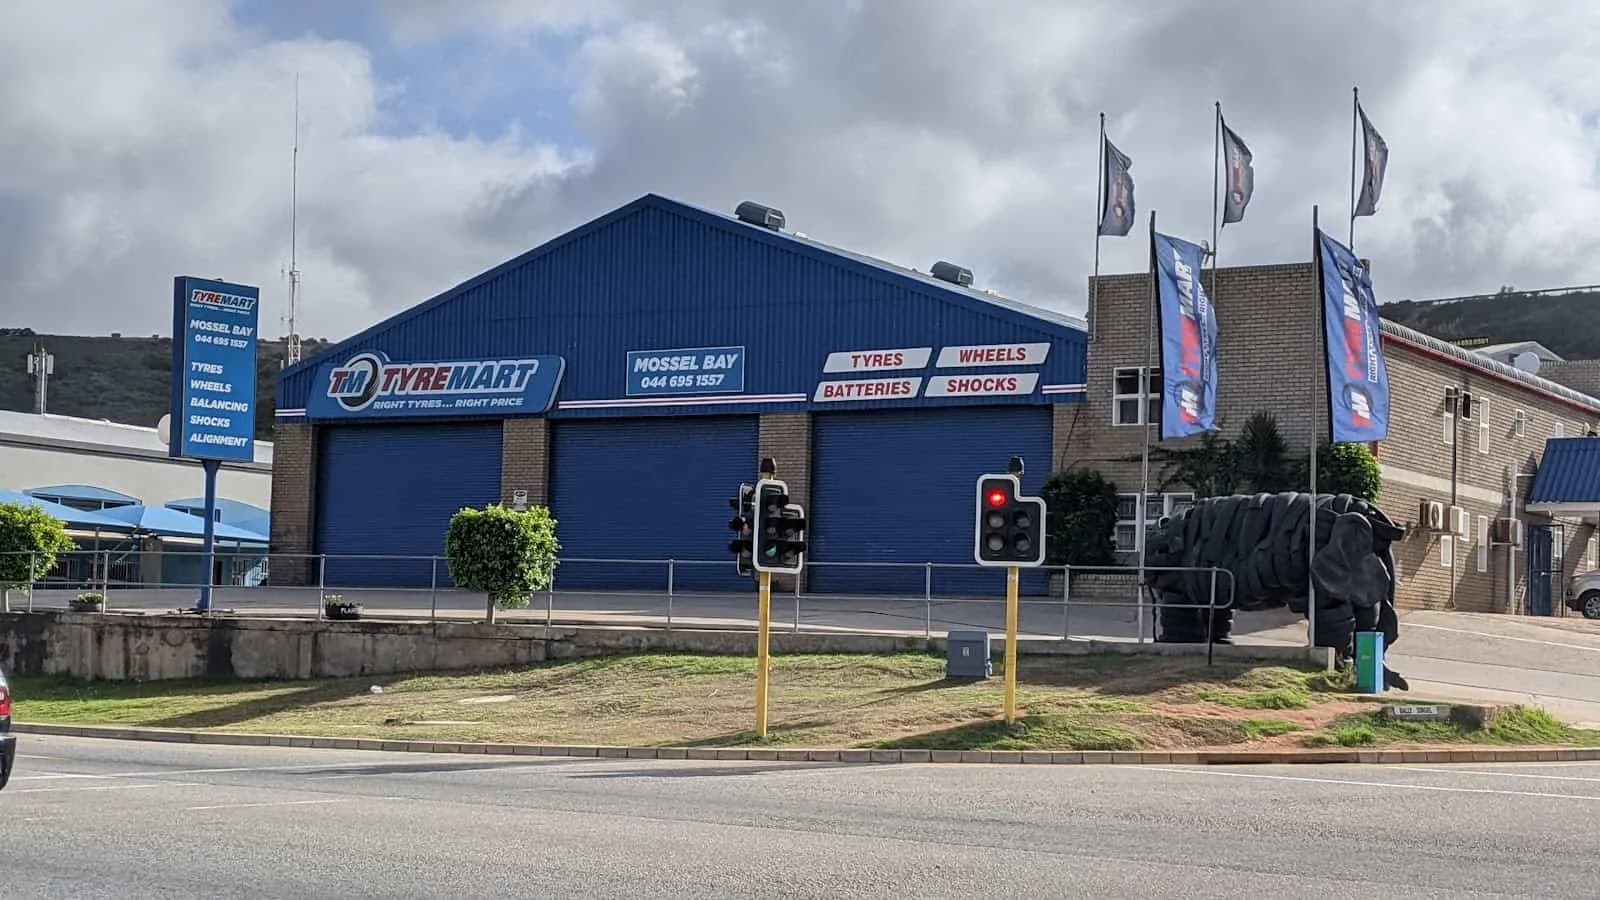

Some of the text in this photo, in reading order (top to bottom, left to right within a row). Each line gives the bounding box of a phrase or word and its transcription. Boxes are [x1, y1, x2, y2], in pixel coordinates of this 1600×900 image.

[192, 290, 255, 309] TYREMART
[190, 319, 253, 336] MOSSEL BAY
[195, 334, 212, 344] 044
[634, 353, 738, 372] MOSSEL BAY
[852, 353, 904, 368] TYRES
[959, 348, 1026, 363] WHEELS
[191, 361, 223, 375] TYRES
[330, 371, 368, 394] TM
[381, 364, 536, 392] TYREMART
[641, 374, 725, 388] 044 695 1557
[946, 377, 1017, 393] SHOCKS
[191, 380, 232, 393] WHEELS
[823, 381, 912, 398] BATTERIES
[190, 397, 248, 412] BALANCING
[373, 398, 524, 409] RIGHT TYRES... RIGHT PRICE
[190, 415, 231, 428] SHOCKS
[190, 433, 248, 447] ALIGNMENT
